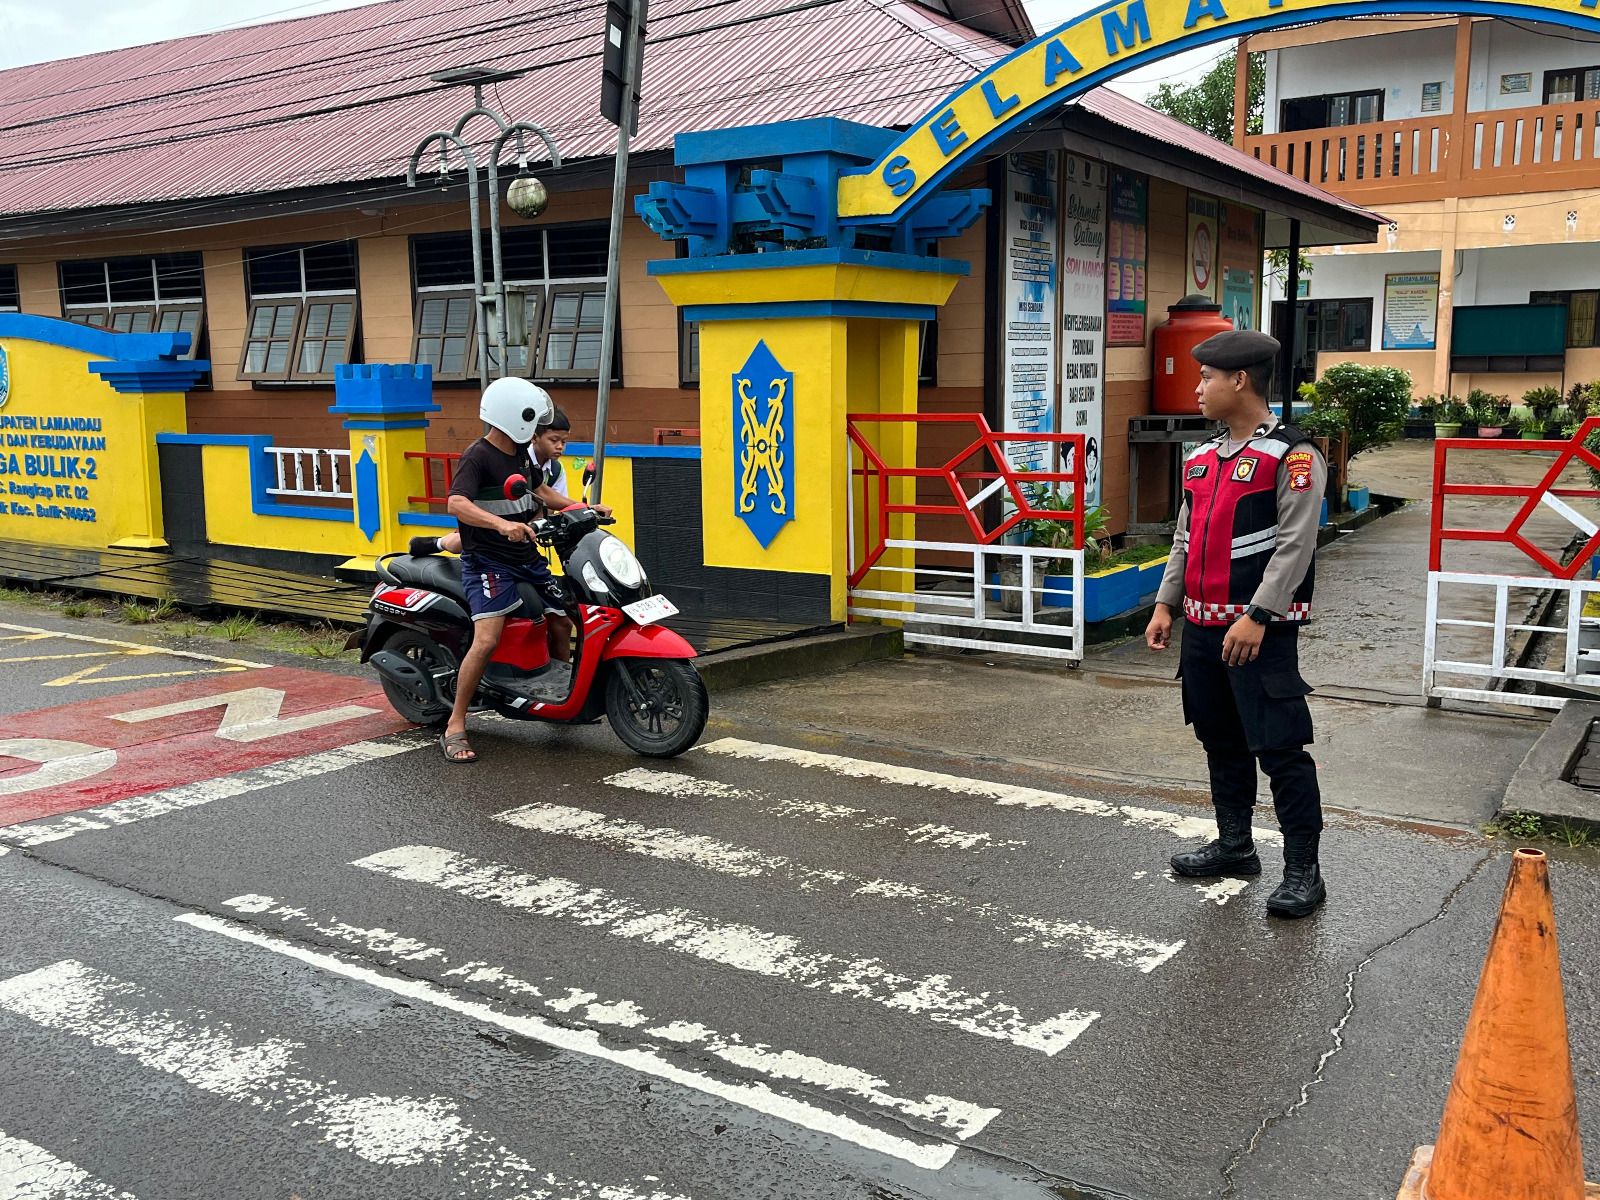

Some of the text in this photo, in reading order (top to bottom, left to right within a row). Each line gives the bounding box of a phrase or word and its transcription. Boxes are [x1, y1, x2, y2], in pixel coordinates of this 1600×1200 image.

[882, 0, 1284, 196] SELAMA
[1067, 193, 1101, 224] Selamat
[1073, 220, 1104, 259] Datang
[1065, 256, 1081, 276] SDN
[1082, 259, 1105, 279] NANGA
[40, 416, 102, 432] LAMANDAU
[7, 434, 28, 447] DAN
[30, 434, 106, 451] KEBUDAYAAN
[24, 454, 98, 480] BULIK-2
[8, 480, 53, 500] Rangkap
[55, 484, 73, 499] RT.
[74, 485, 89, 500] 02
[10, 501, 34, 516] Kec.
